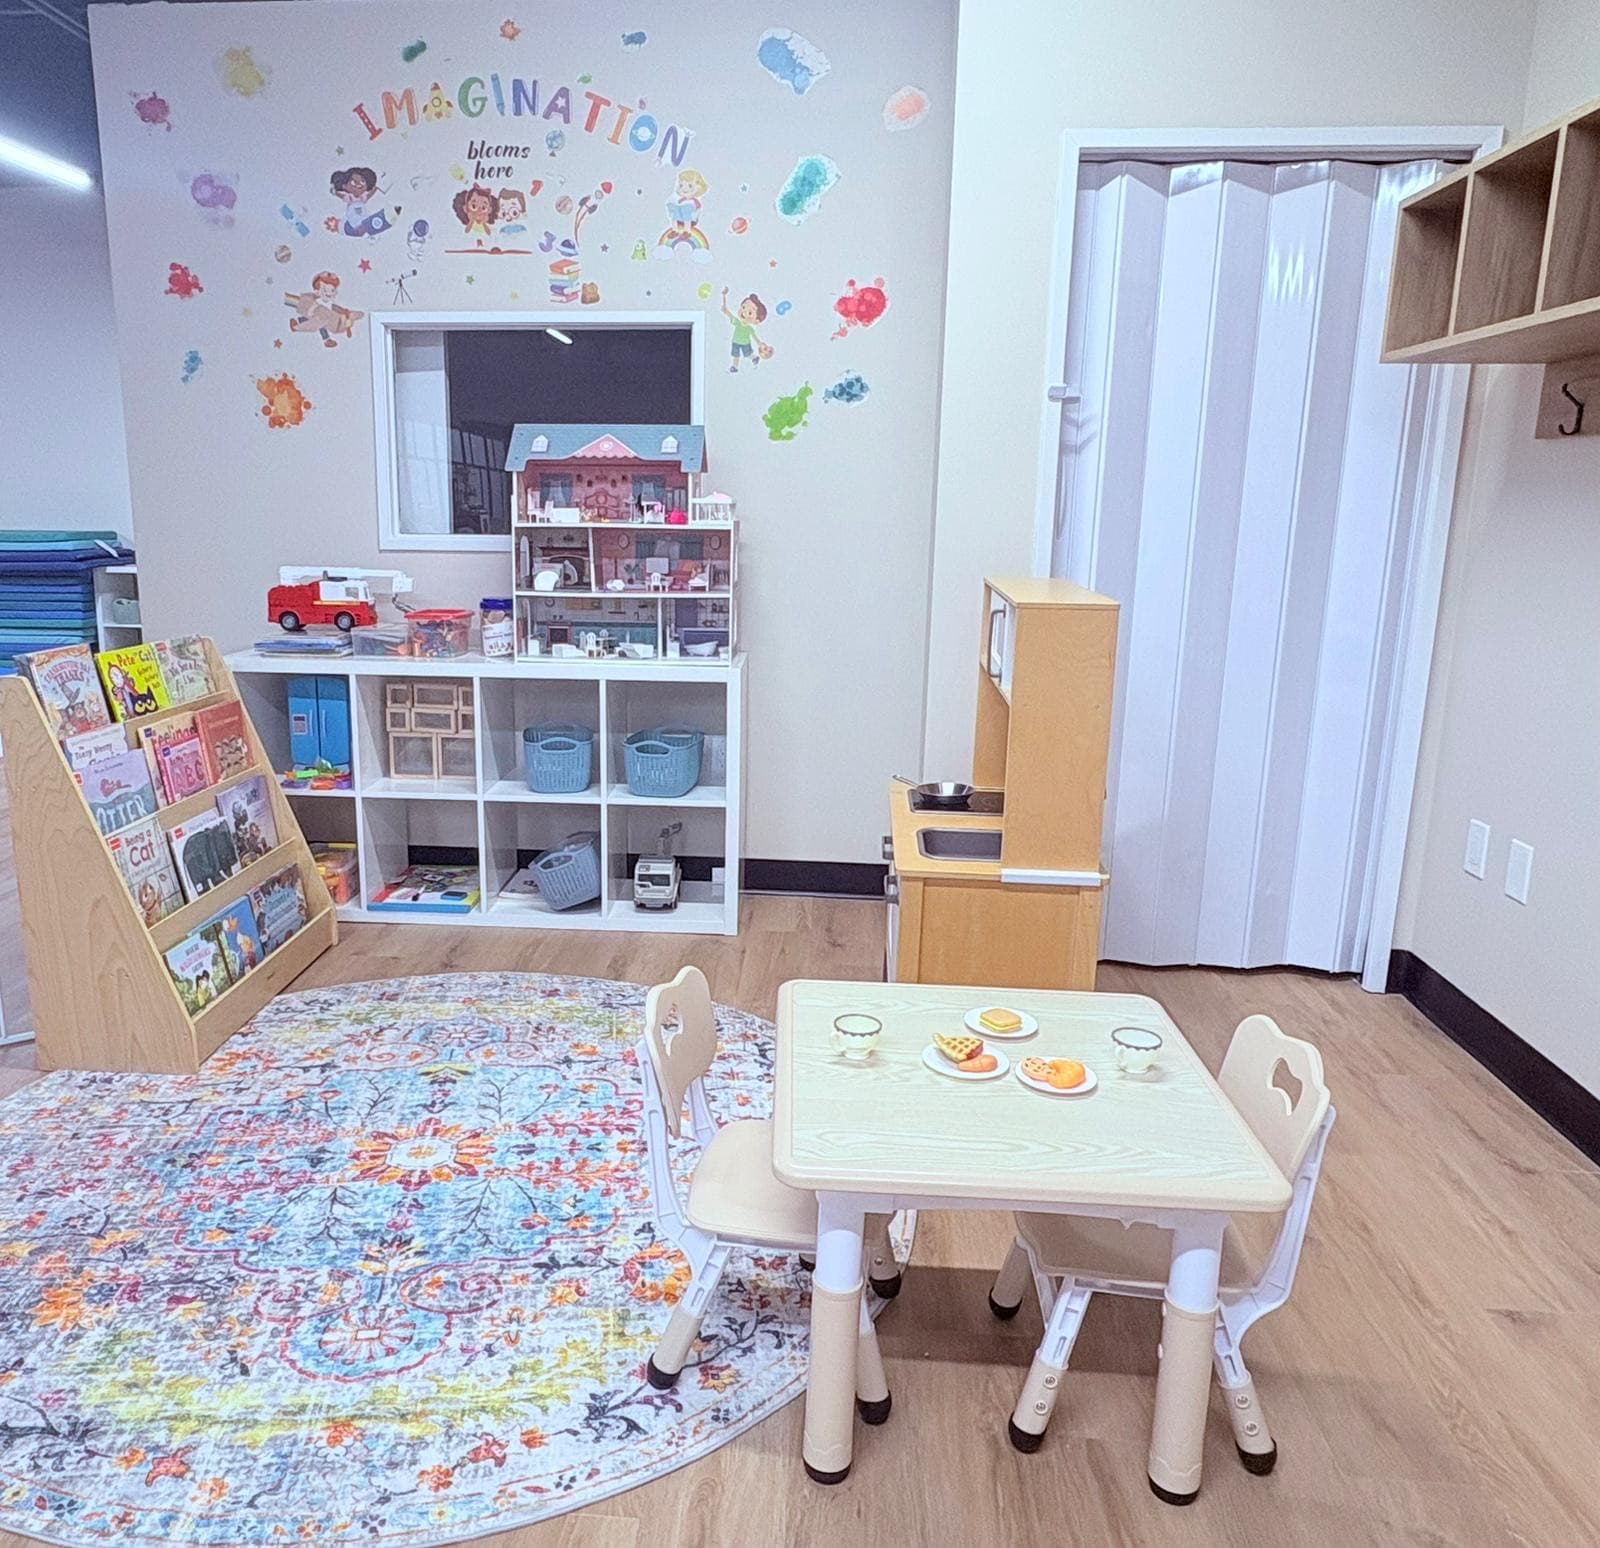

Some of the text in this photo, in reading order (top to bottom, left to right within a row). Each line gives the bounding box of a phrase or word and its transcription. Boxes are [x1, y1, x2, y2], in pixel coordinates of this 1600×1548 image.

[352, 73, 691, 167] IMAGINATION
[467, 140, 531, 160] blooms
[116, 654, 136, 668] Pete
[129, 839, 155, 867] Cat
